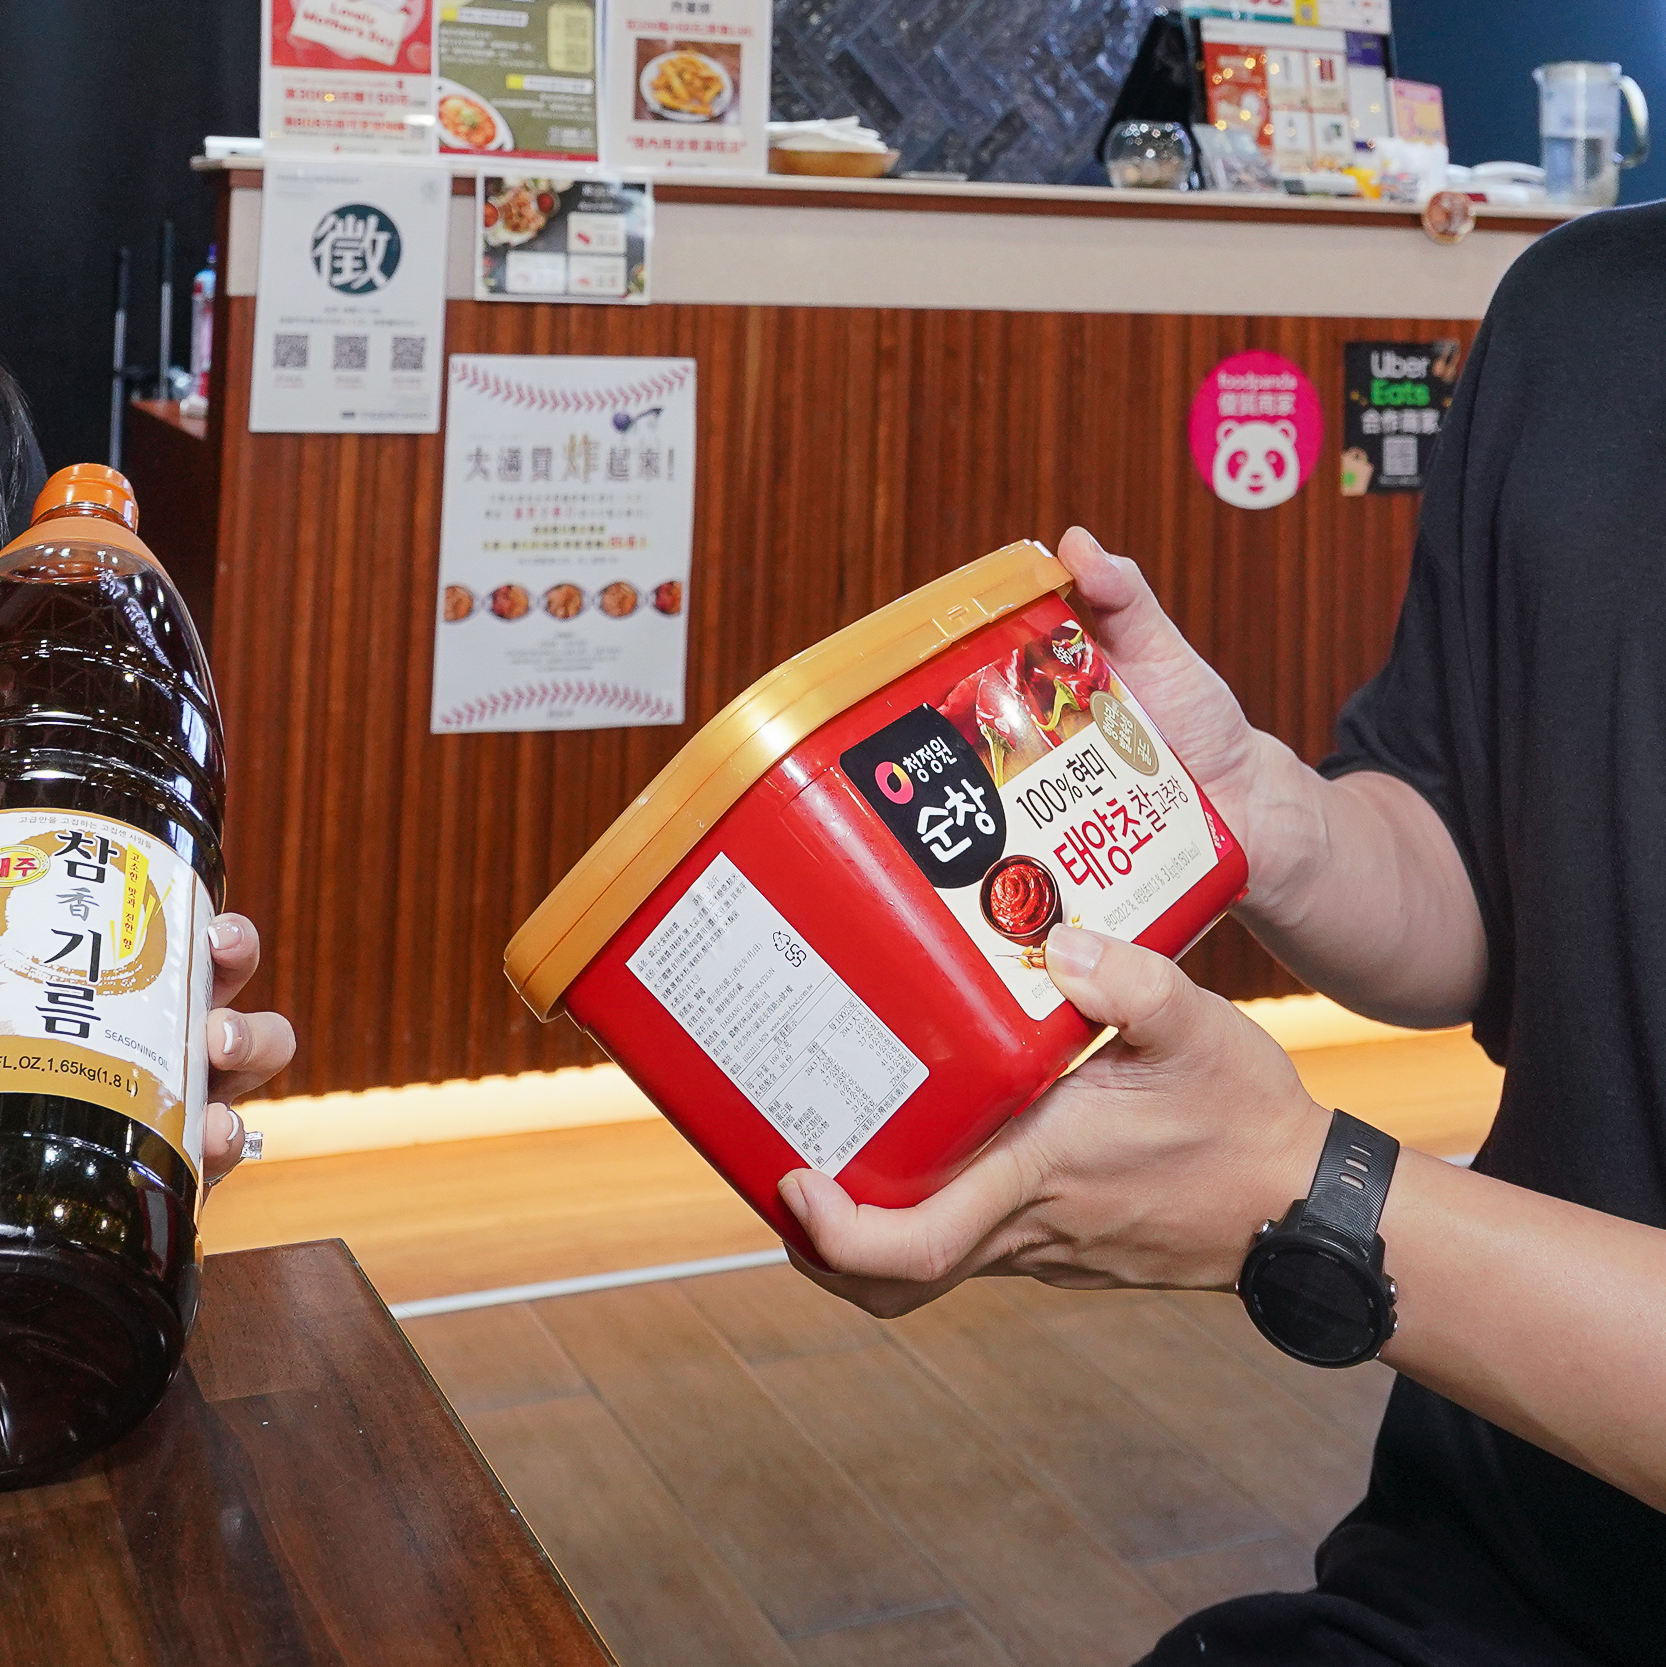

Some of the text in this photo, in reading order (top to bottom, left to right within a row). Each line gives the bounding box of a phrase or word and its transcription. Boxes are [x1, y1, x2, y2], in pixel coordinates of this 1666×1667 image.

[311, 214, 392, 290] 徵
[1370, 350, 1431, 379] Uber
[1370, 378, 1431, 406] Eats
[902, 736, 958, 783] 청정원
[916, 778, 996, 863] 순창
[719, 1002, 743, 1030] DAESANG
[739, 966, 776, 1007] CORPORATION
[105, 1029, 169, 1071] SEASONING OIL
